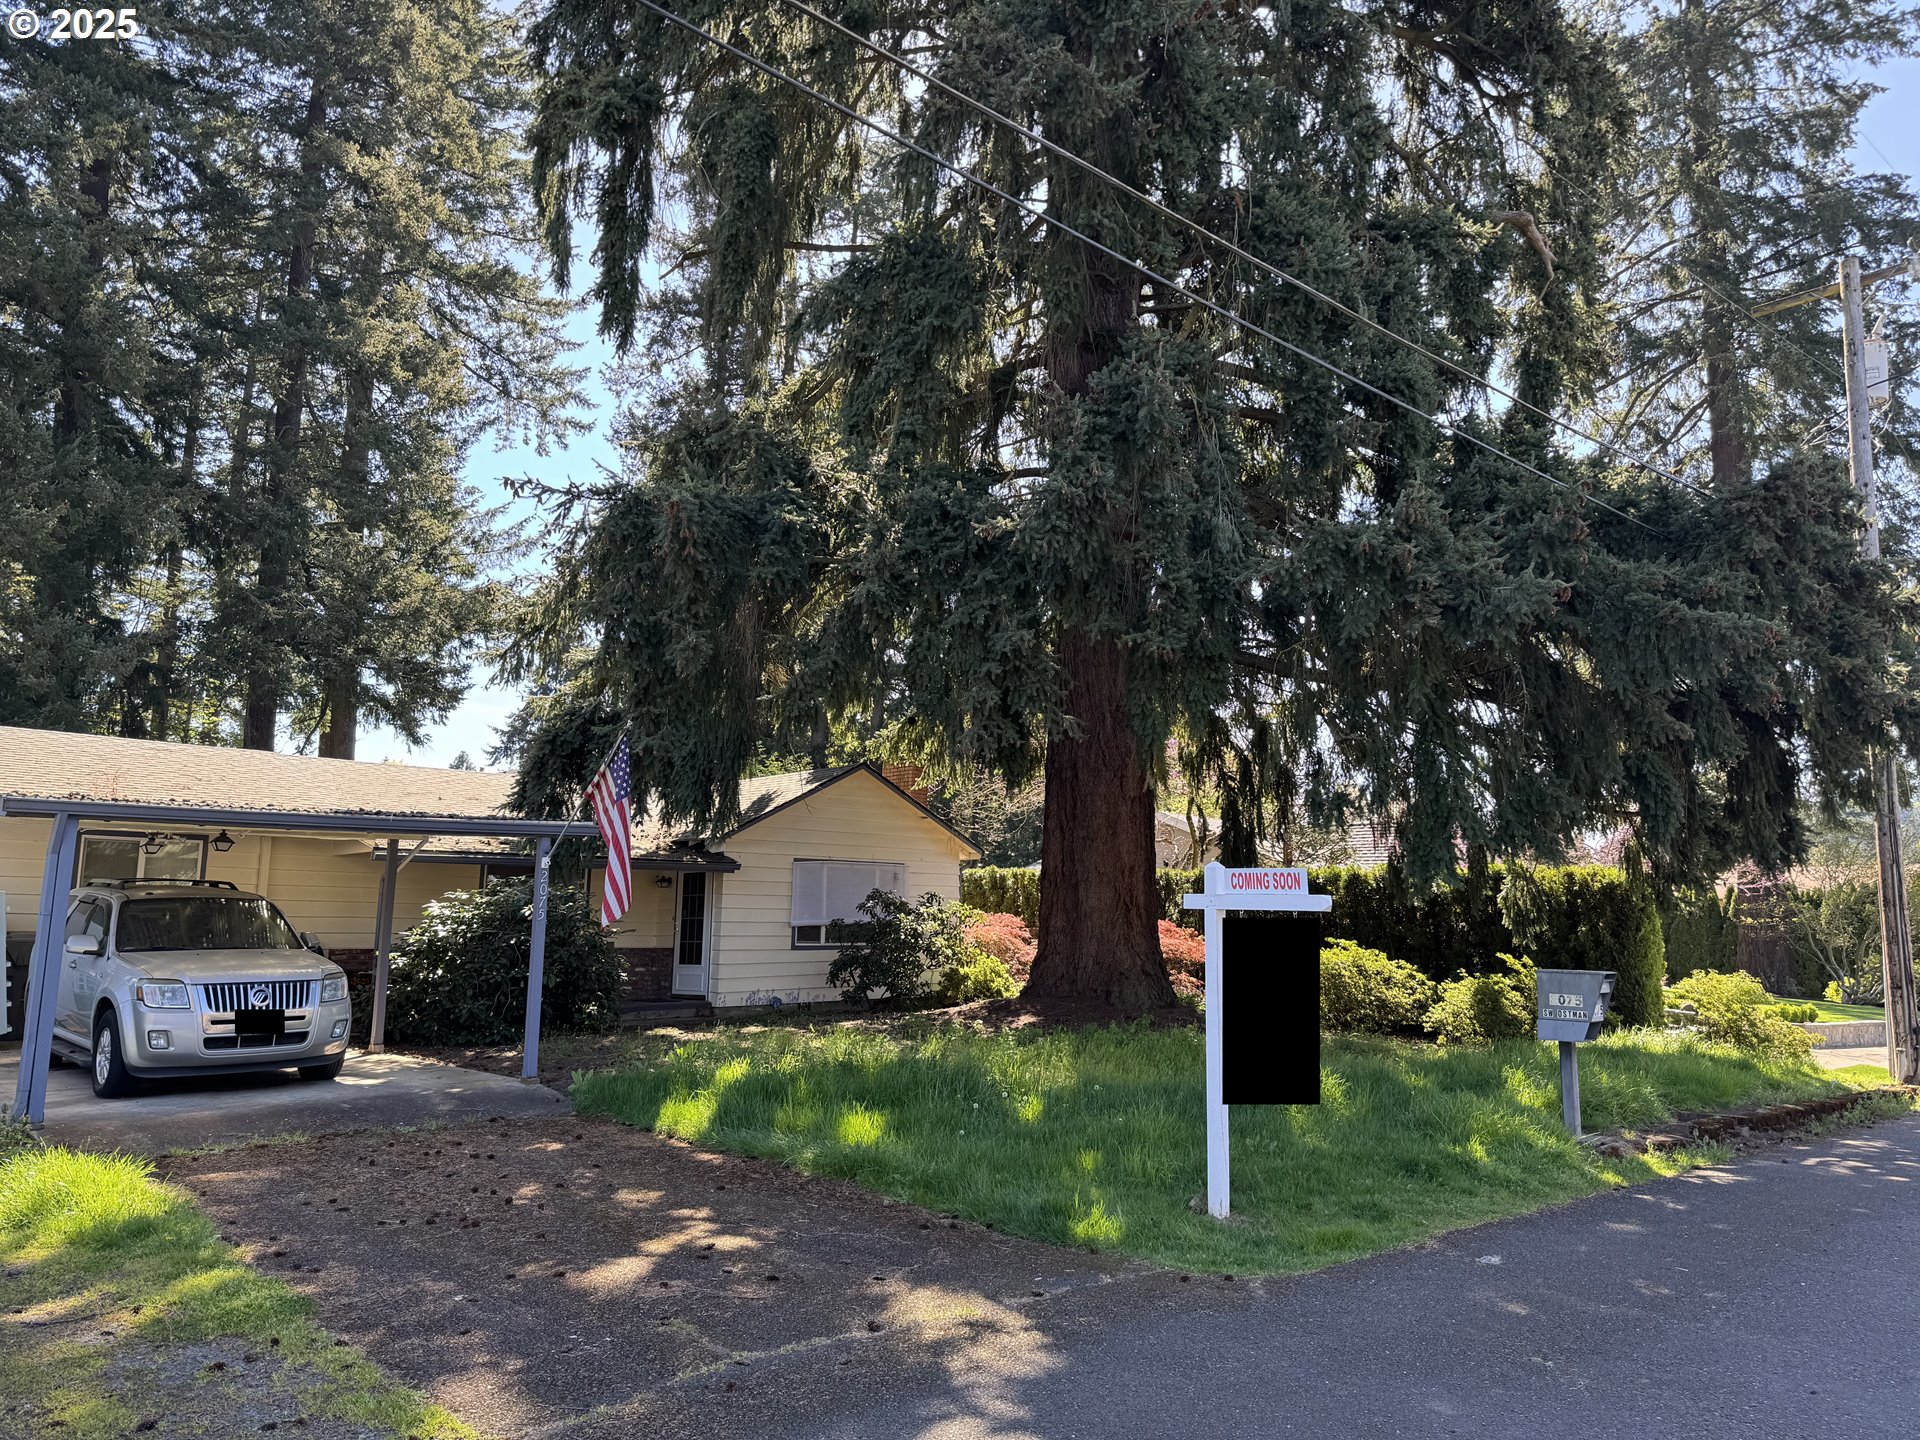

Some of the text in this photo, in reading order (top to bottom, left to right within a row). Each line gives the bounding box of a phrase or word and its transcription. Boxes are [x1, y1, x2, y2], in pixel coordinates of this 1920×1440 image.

[1230, 872, 1301, 891] COMING SOON
[538, 870, 548, 920] 2075
[1543, 1009, 1553, 1017] SW
[1557, 1010, 1588, 1019] OSTMAN
